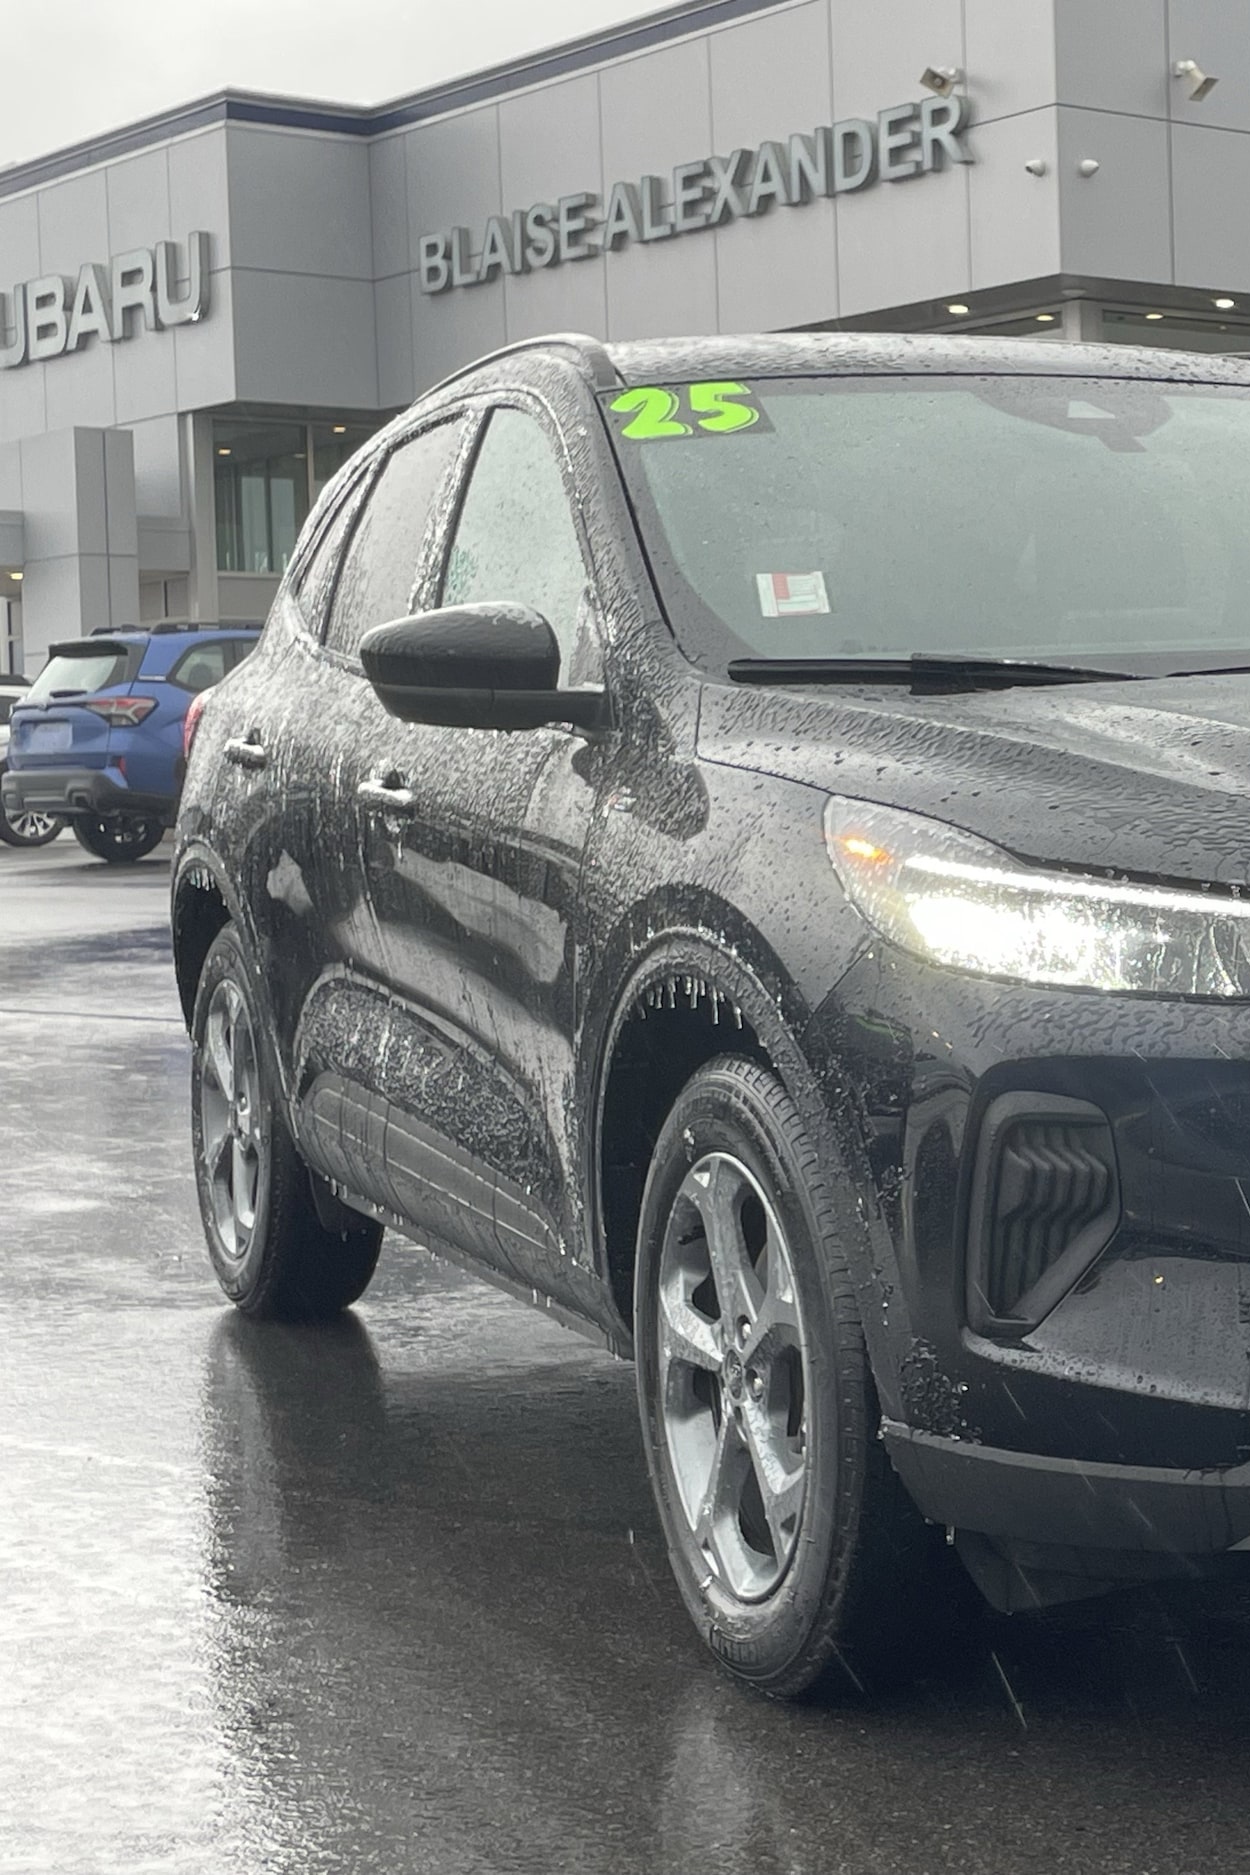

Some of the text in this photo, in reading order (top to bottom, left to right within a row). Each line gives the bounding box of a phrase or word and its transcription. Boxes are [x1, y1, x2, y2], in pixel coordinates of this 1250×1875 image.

[419, 95, 974, 295] BLAISE ALEXANDER
[610, 381, 759, 440] 25
